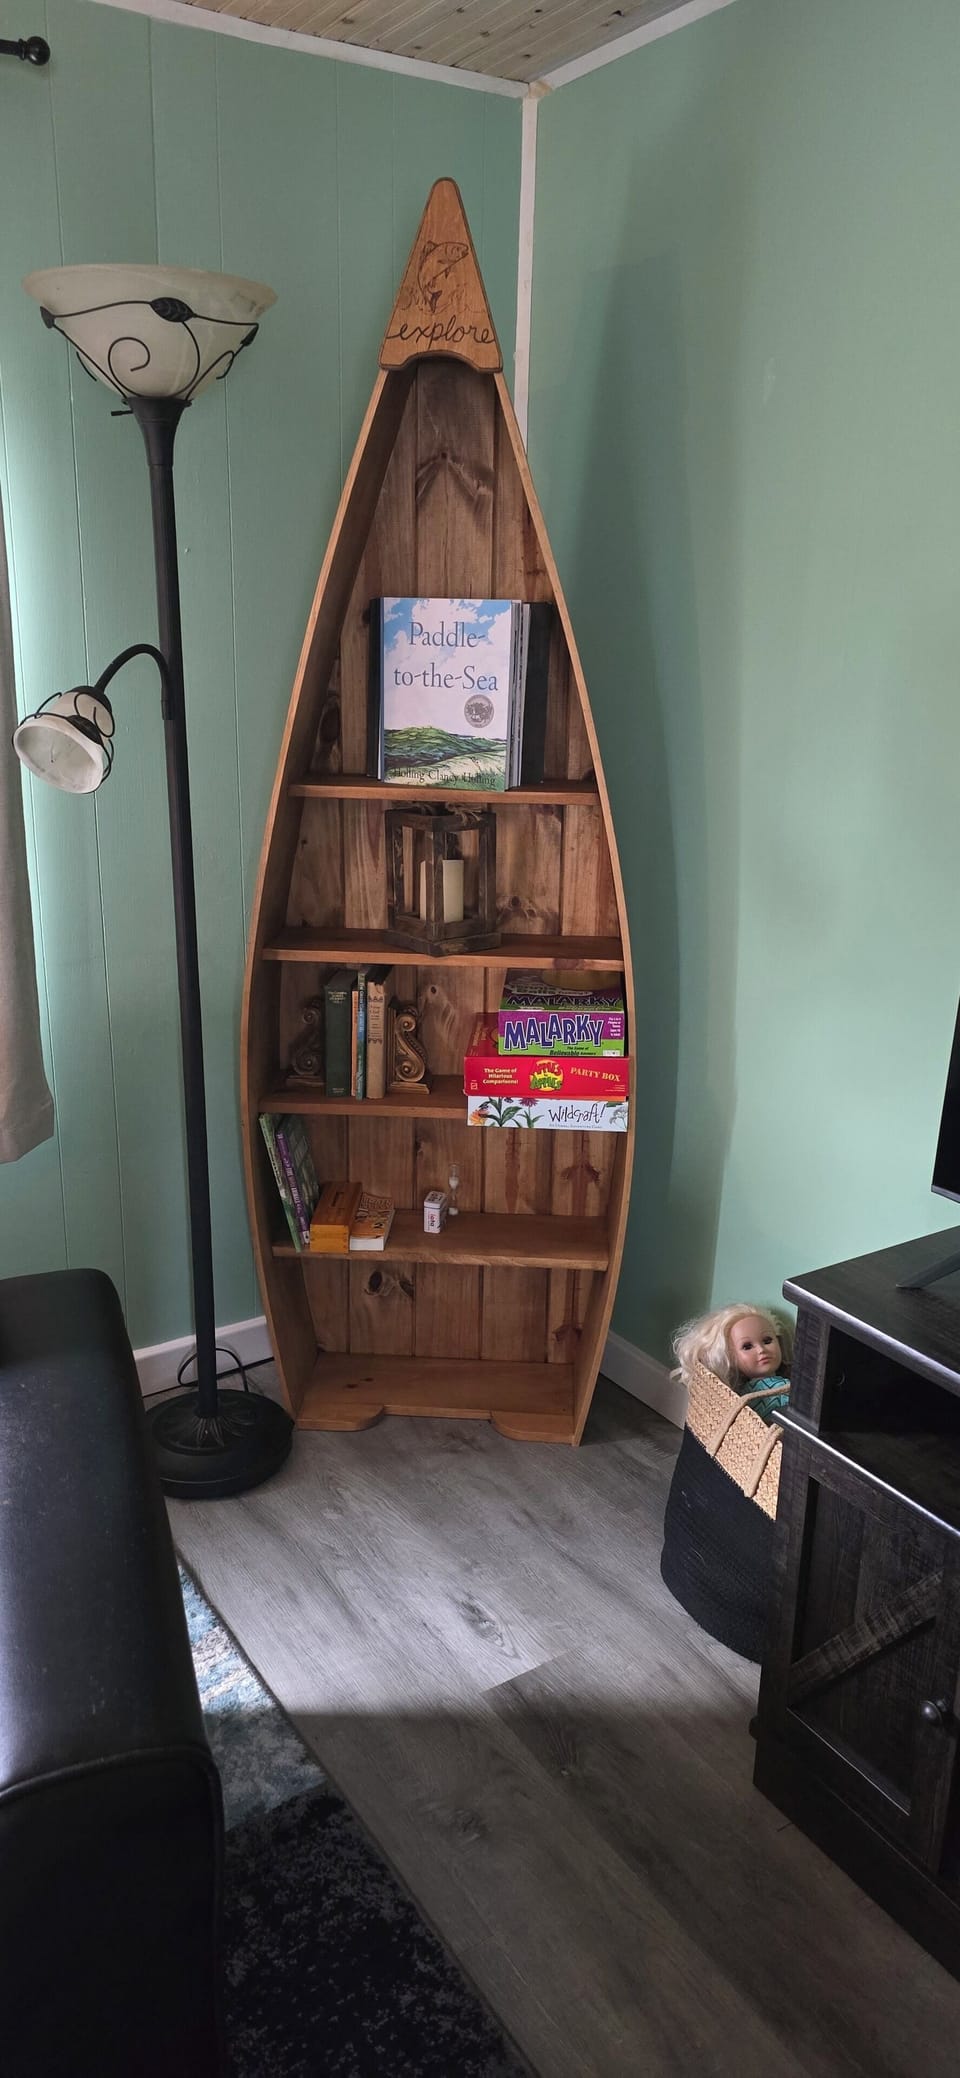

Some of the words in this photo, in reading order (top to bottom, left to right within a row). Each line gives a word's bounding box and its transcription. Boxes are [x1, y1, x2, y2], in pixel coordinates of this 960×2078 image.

[386, 315, 495, 350] explore
[408, 621, 486, 648] Paddle-
[393, 662, 499, 691] to-the-Sea
[504, 1014, 604, 1051] MALARKY
[570, 1067, 601, 1078] PARTY
[602, 1072, 621, 1082] BOX
[548, 1103, 606, 1124] Wildcraft!
